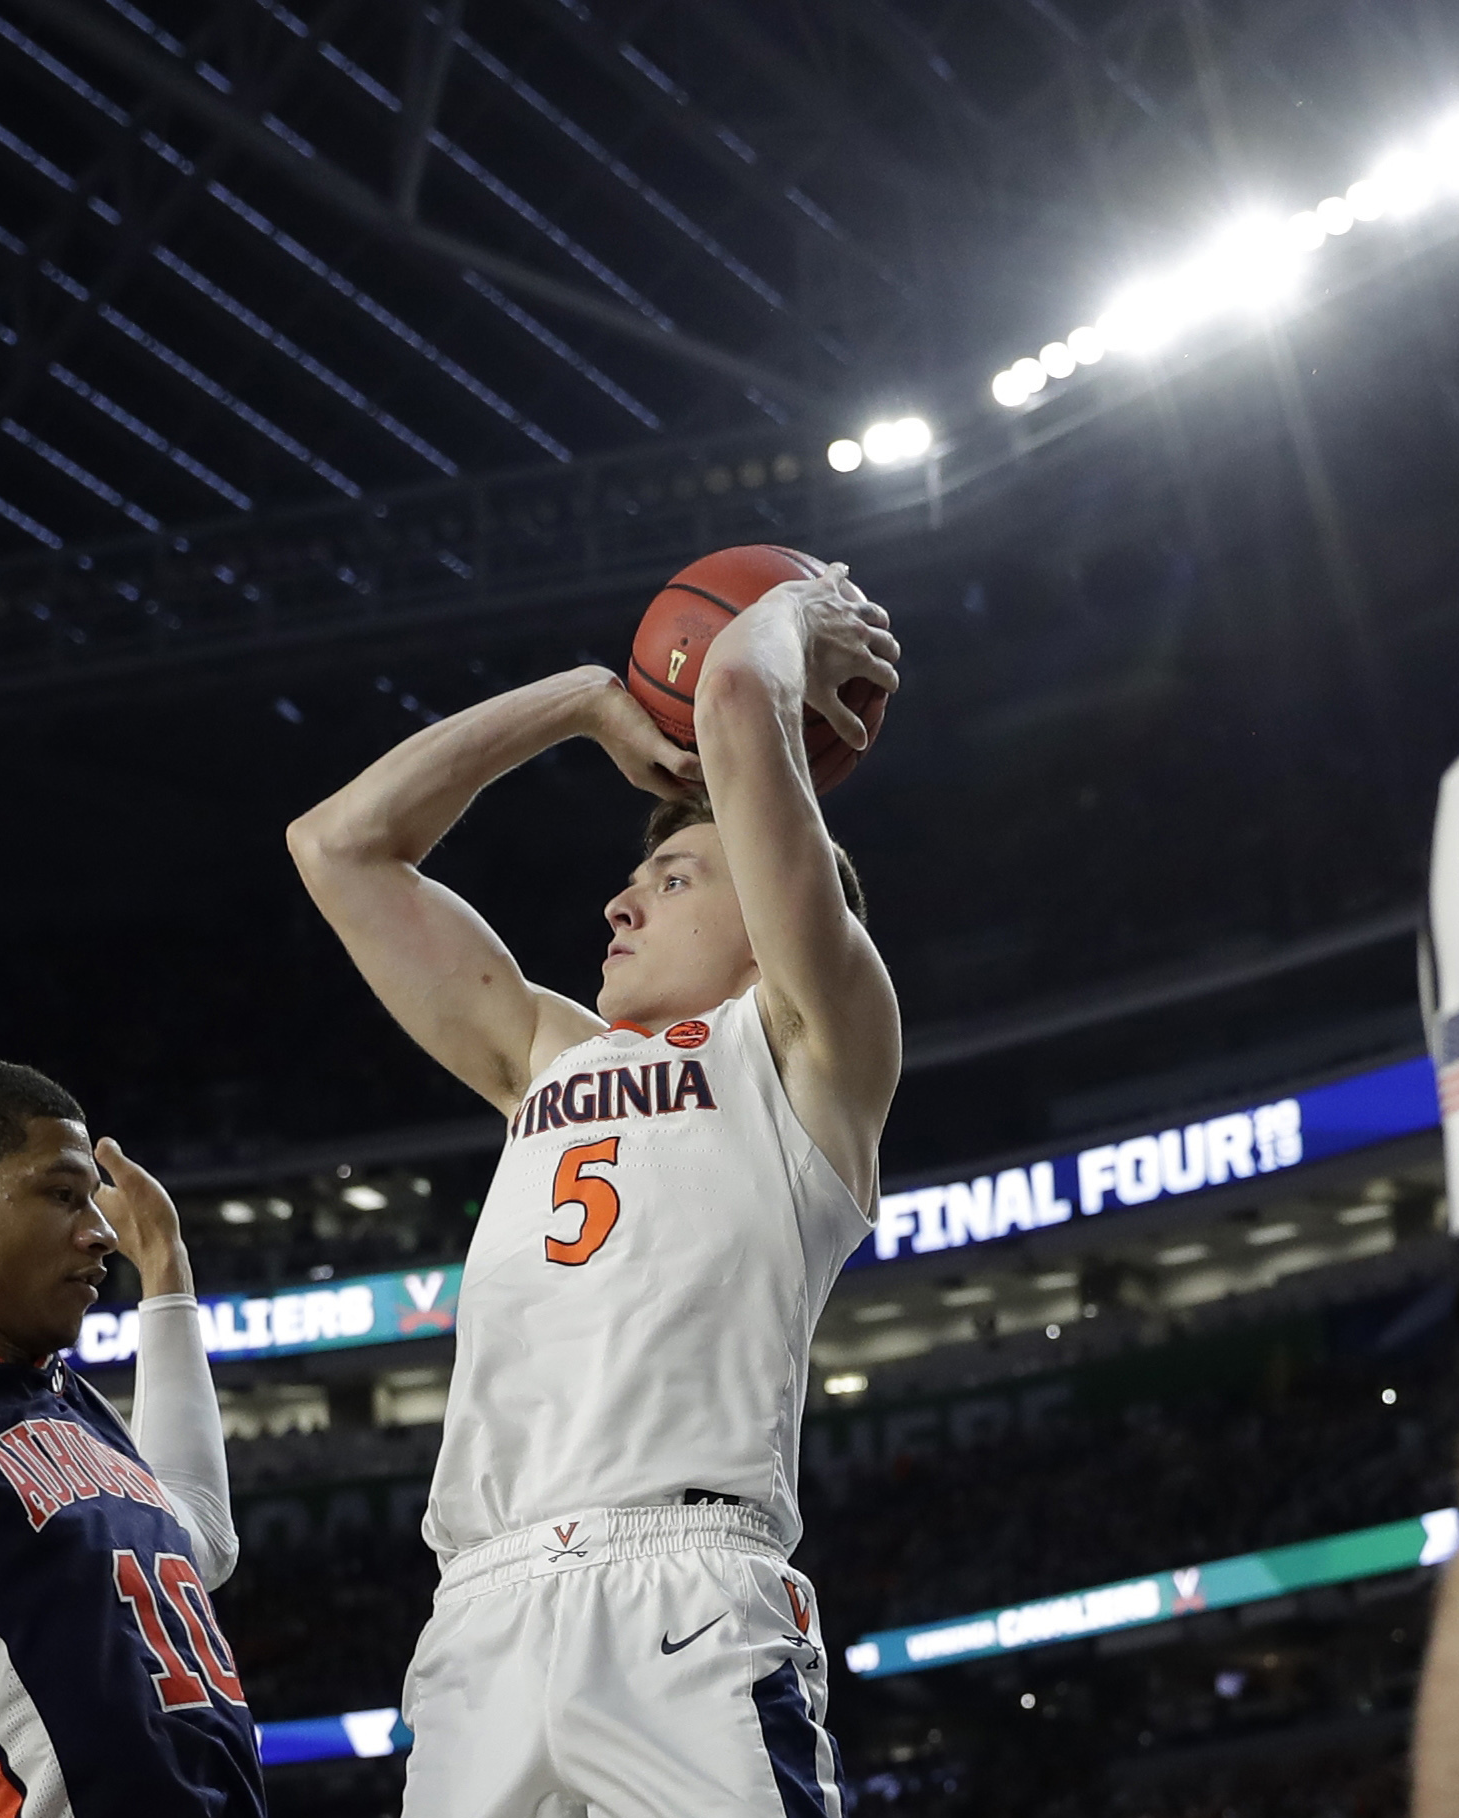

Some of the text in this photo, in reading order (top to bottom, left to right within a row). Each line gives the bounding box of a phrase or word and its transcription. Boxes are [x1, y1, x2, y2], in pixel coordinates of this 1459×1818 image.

[511, 1060, 717, 1140] VIRGINIA
[544, 1136, 621, 1267] 5
[874, 1112, 1256, 1260] FINAL FOUR
[80, 1285, 374, 1363] CAALIERS
[112, 1549, 248, 1713] 10
